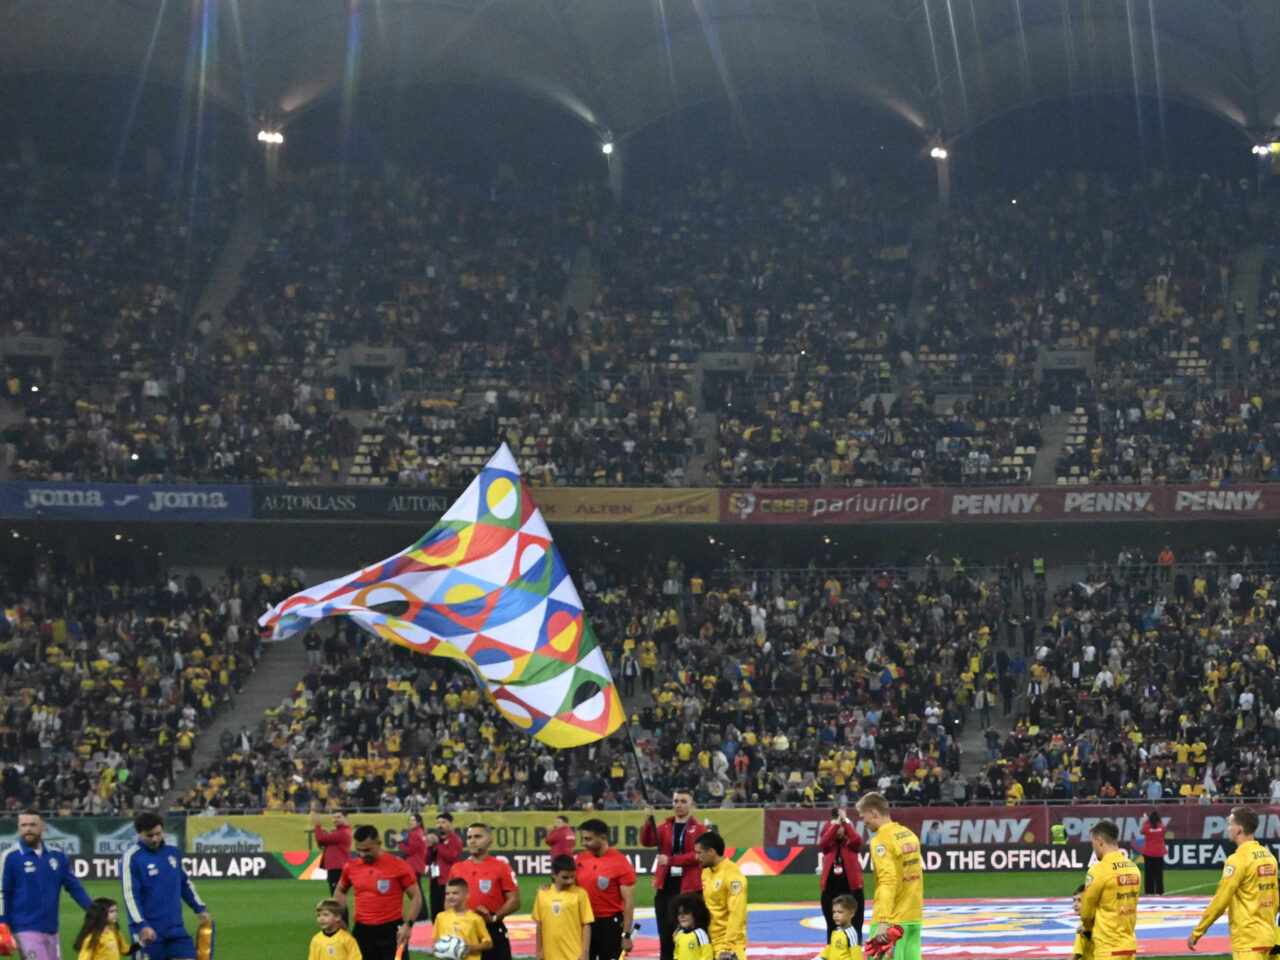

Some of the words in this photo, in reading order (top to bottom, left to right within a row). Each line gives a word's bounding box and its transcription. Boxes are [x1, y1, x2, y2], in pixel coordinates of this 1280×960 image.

[262, 495, 356, 511] AUTOKLASS
[388, 496, 447, 511] AUTOK
[759, 500, 809, 513] casa
[813, 495, 931, 516] pariurilor
[951, 494, 1038, 514] PENNY
[1064, 492, 1152, 512] PENNY
[1174, 490, 1262, 510] PENNY
[195, 841, 262, 853] Bergenbier
[1163, 844, 1226, 864] UEFA
[92, 859, 120, 878] TH
[233, 856, 266, 876] APP
[514, 855, 552, 874] THE
[946, 851, 985, 870] THE
[990, 848, 1079, 870] OFFICIAL
